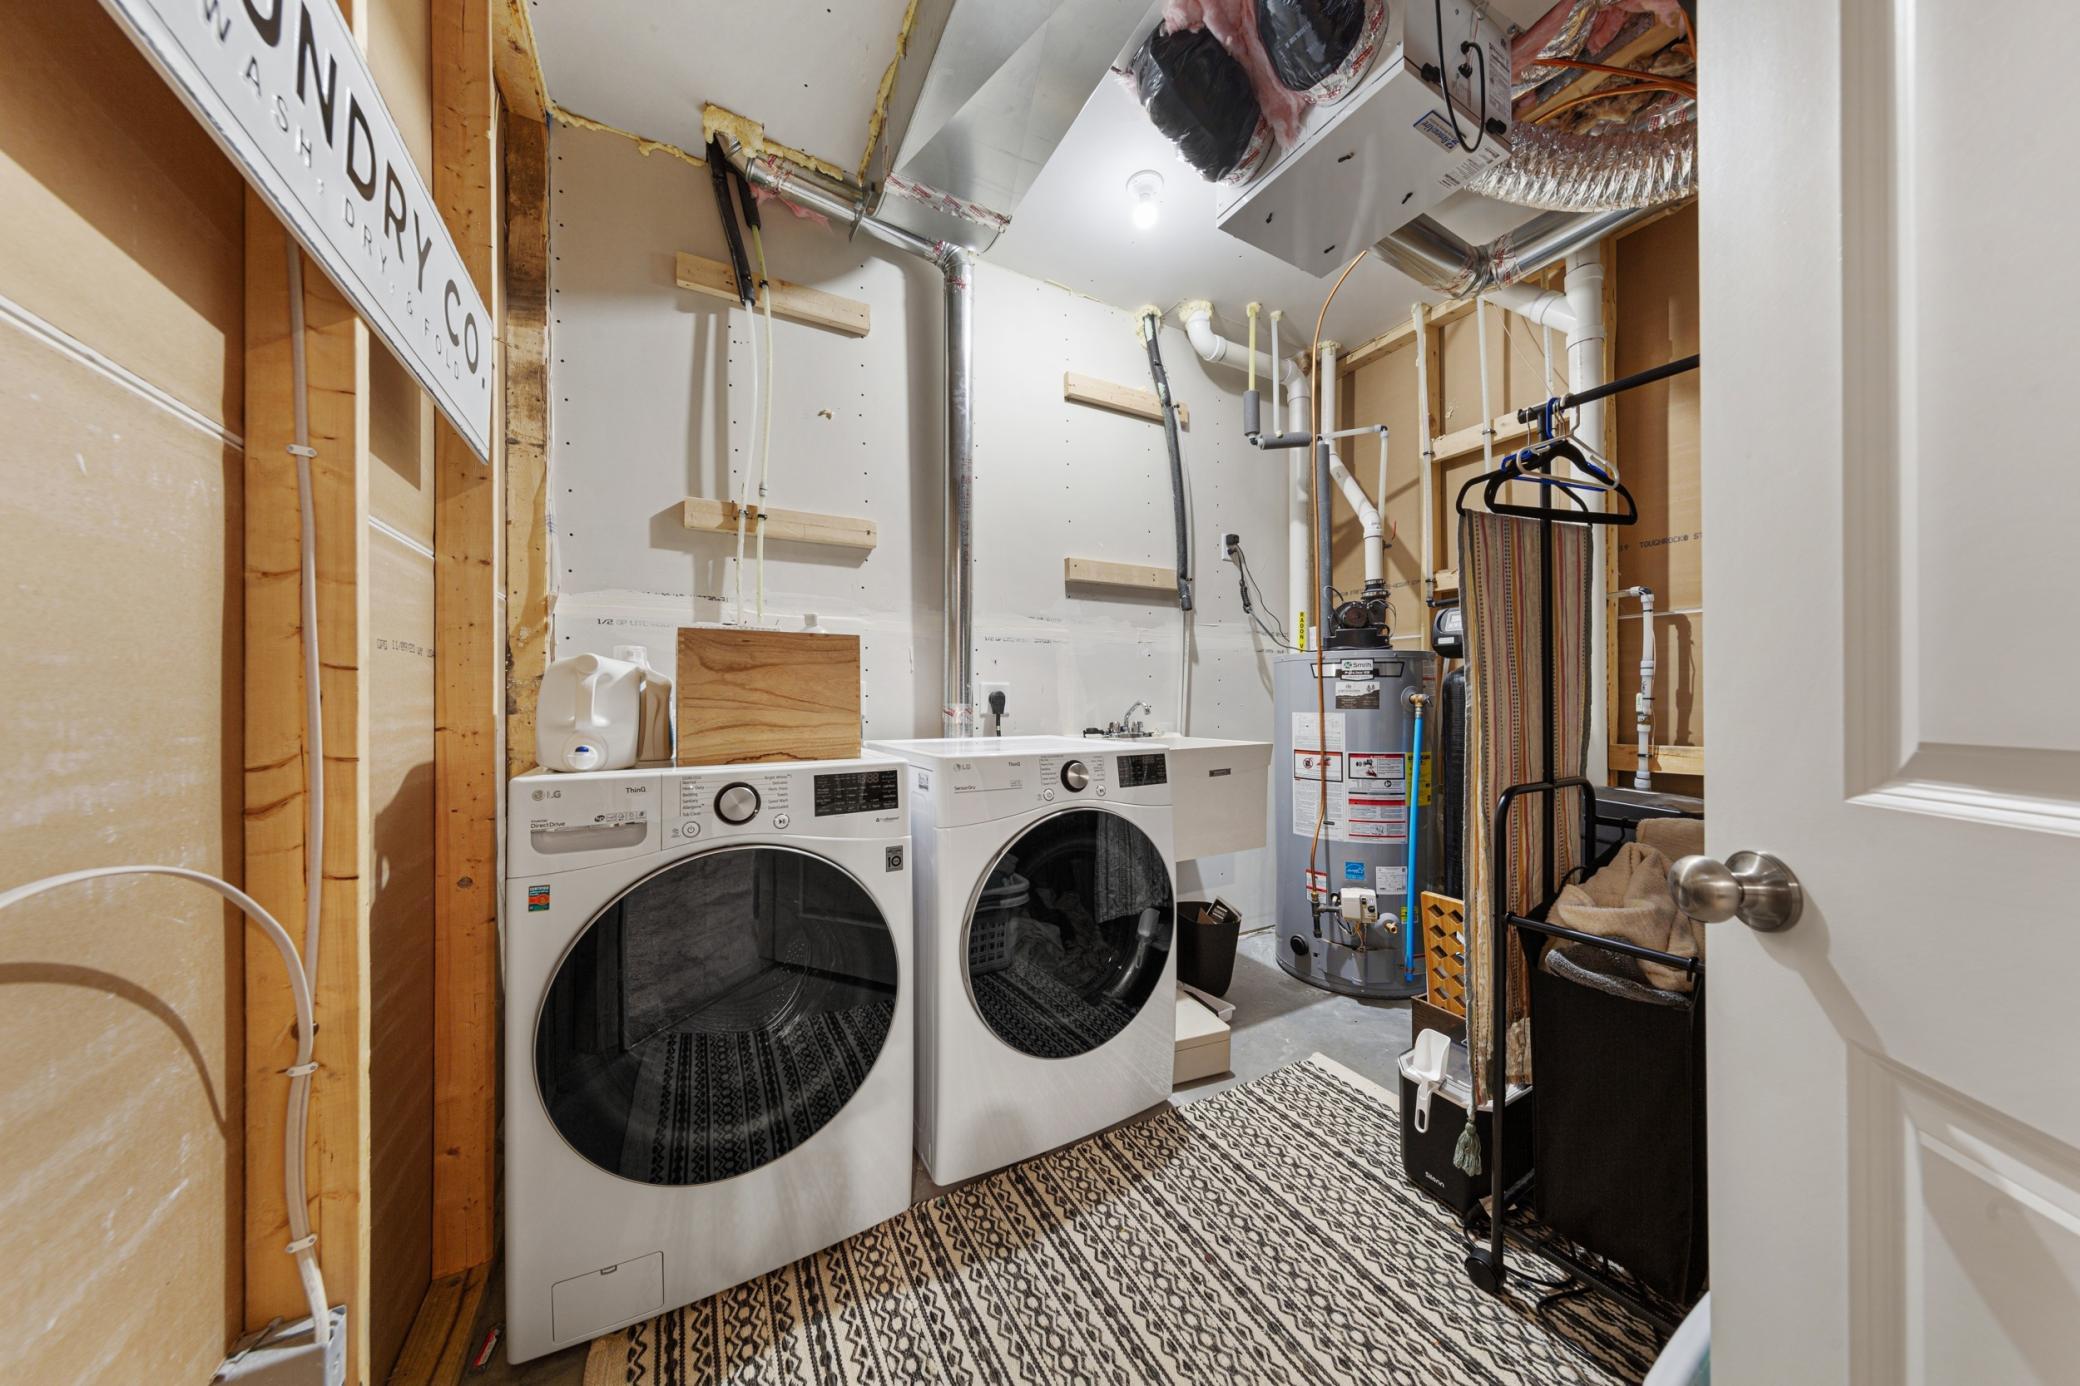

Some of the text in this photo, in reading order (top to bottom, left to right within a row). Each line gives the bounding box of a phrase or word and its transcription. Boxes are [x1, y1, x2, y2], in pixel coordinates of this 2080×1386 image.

[343, 197, 387, 274] DRY
[424, 317, 460, 380] FOLD
[445, 279, 486, 390] CO.
[546, 789, 562, 800] LG
[626, 785, 646, 794] ThinQ
